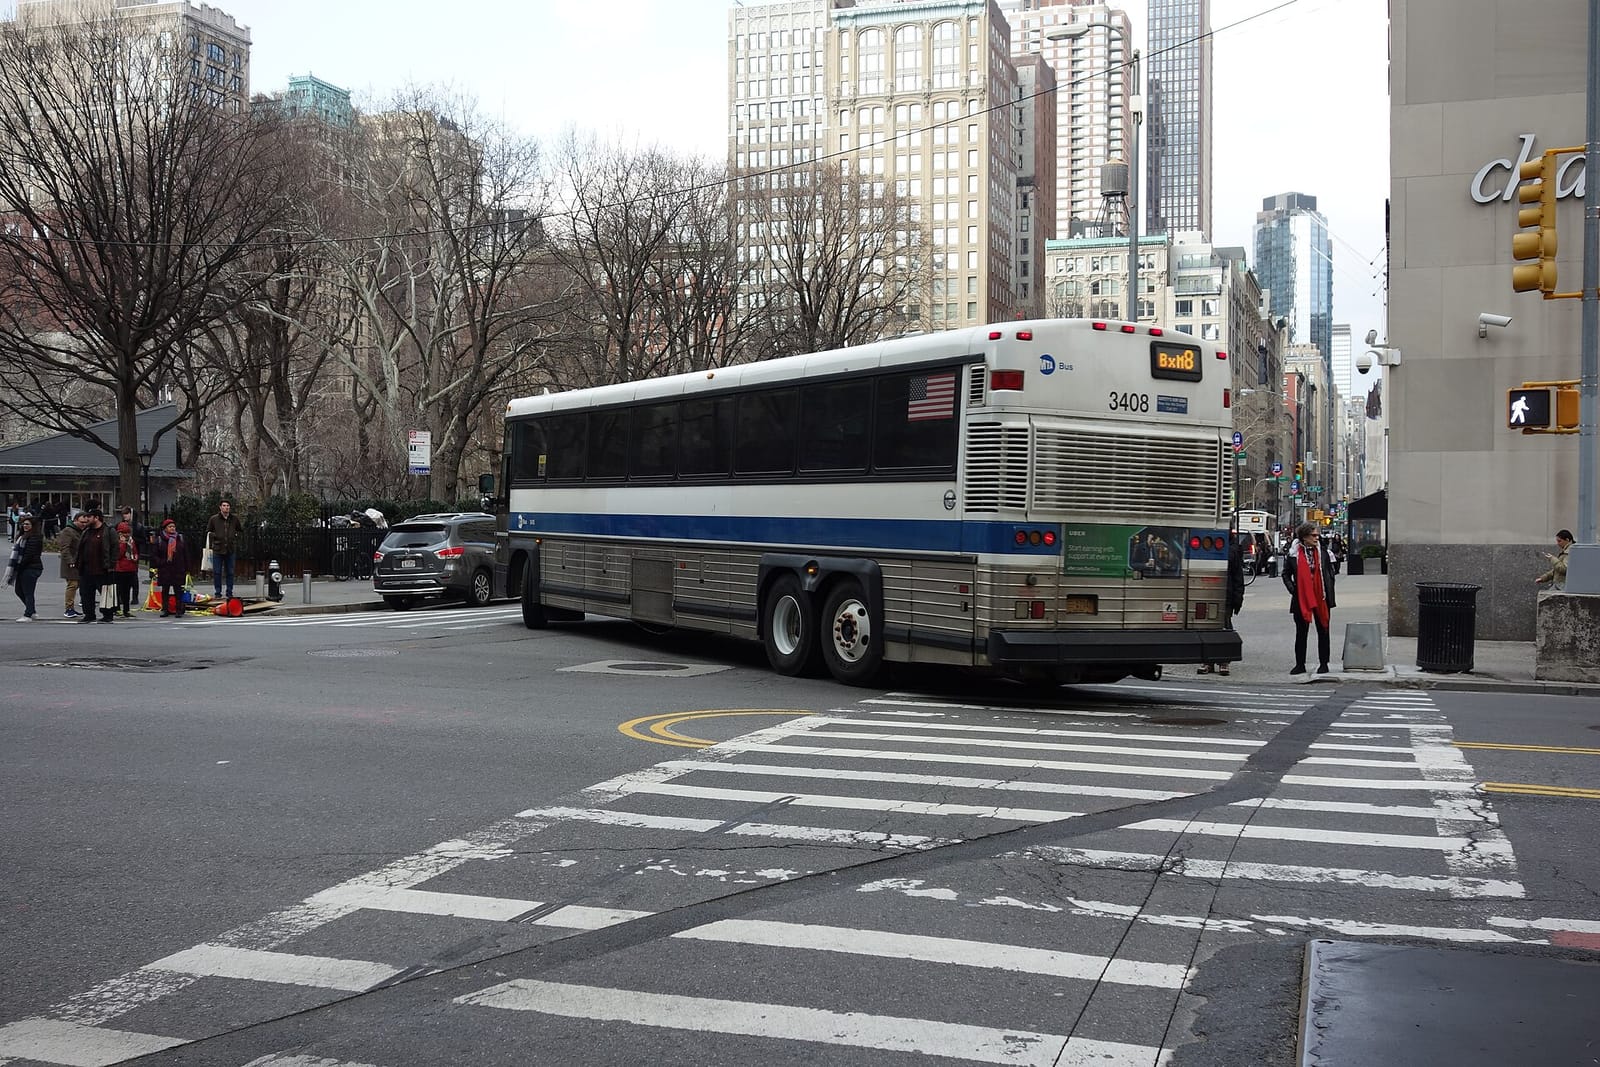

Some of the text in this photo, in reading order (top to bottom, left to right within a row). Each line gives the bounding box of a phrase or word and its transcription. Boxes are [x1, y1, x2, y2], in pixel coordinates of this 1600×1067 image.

[1059, 361, 1073, 371] Bus
[1159, 350, 1194, 369] BxM8
[1109, 391, 1149, 413] 3408
